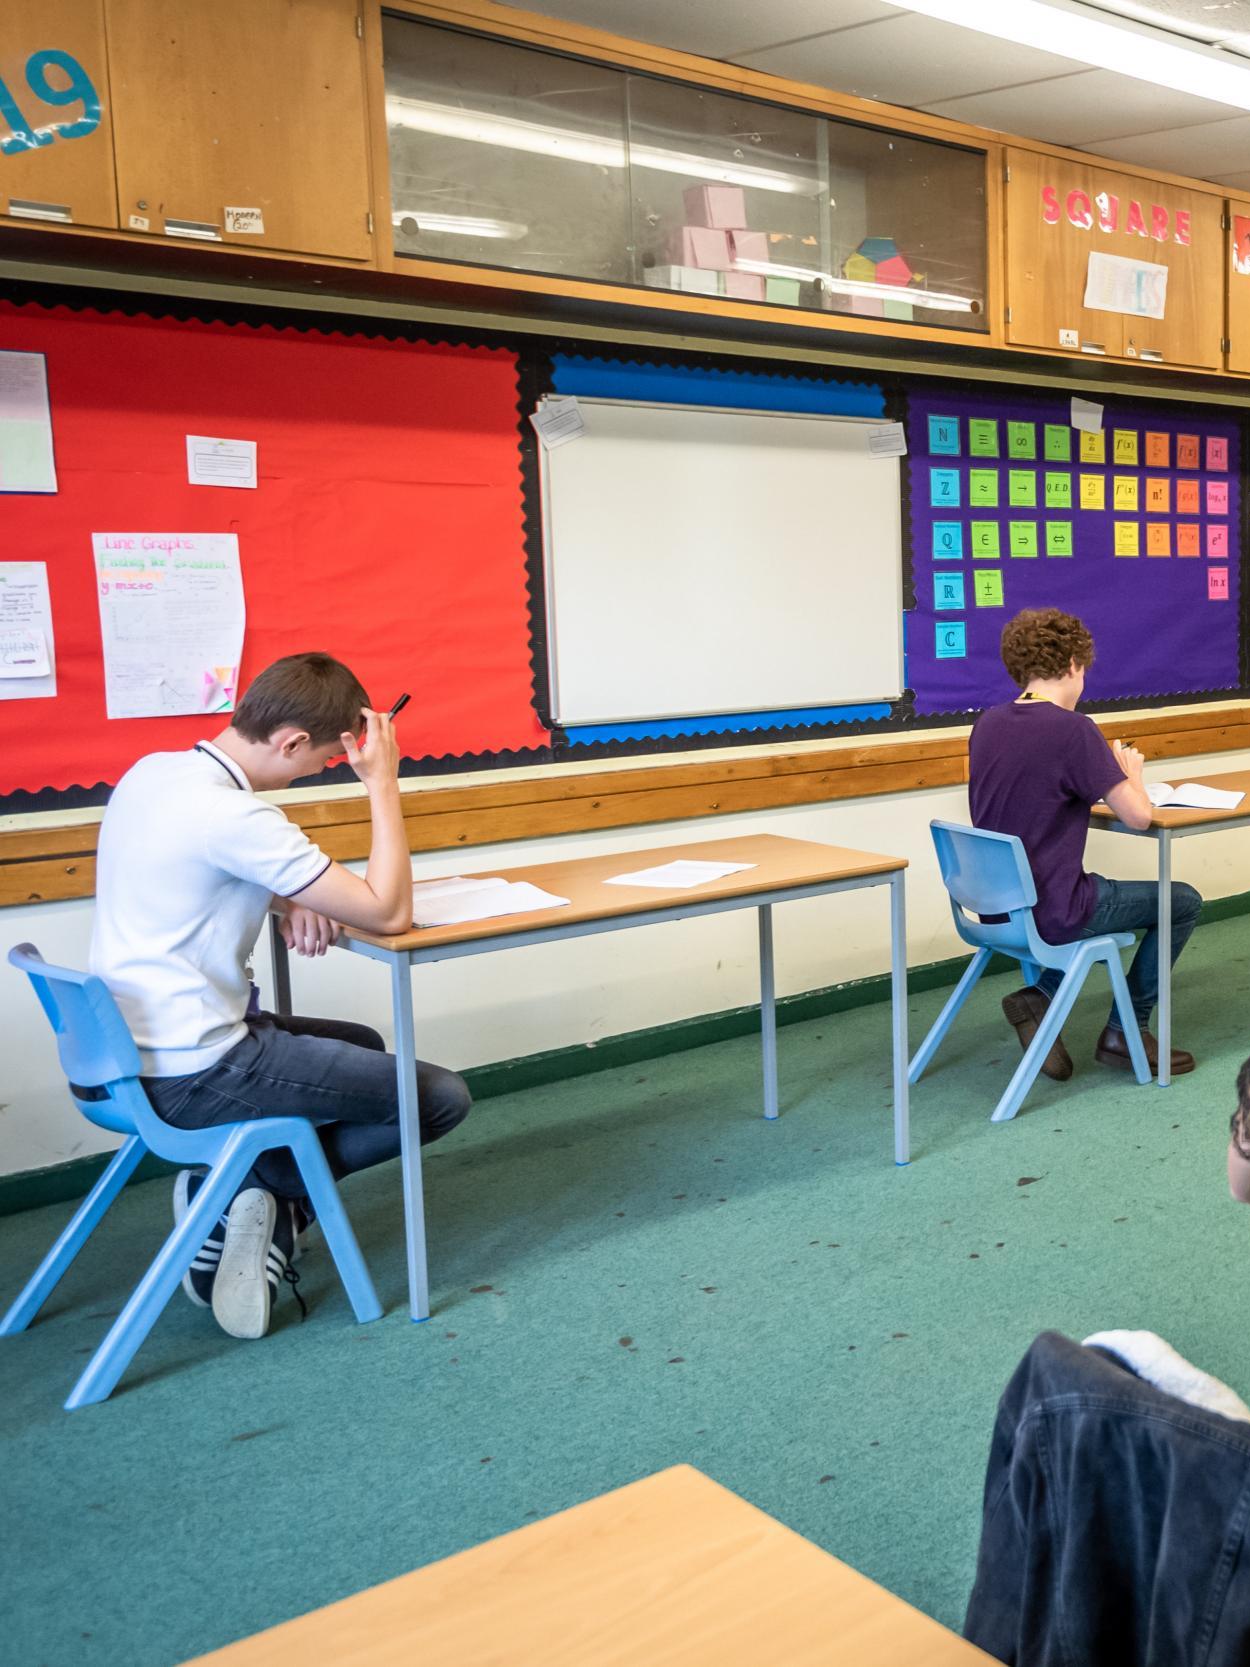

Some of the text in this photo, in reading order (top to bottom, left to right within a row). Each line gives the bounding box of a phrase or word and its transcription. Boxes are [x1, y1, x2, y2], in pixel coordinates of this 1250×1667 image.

[0, 49, 102, 156] 19
[1041, 184, 1192, 247] SQUARE
[104, 535, 137, 550] Line
[941, 532, 953, 549] Q
